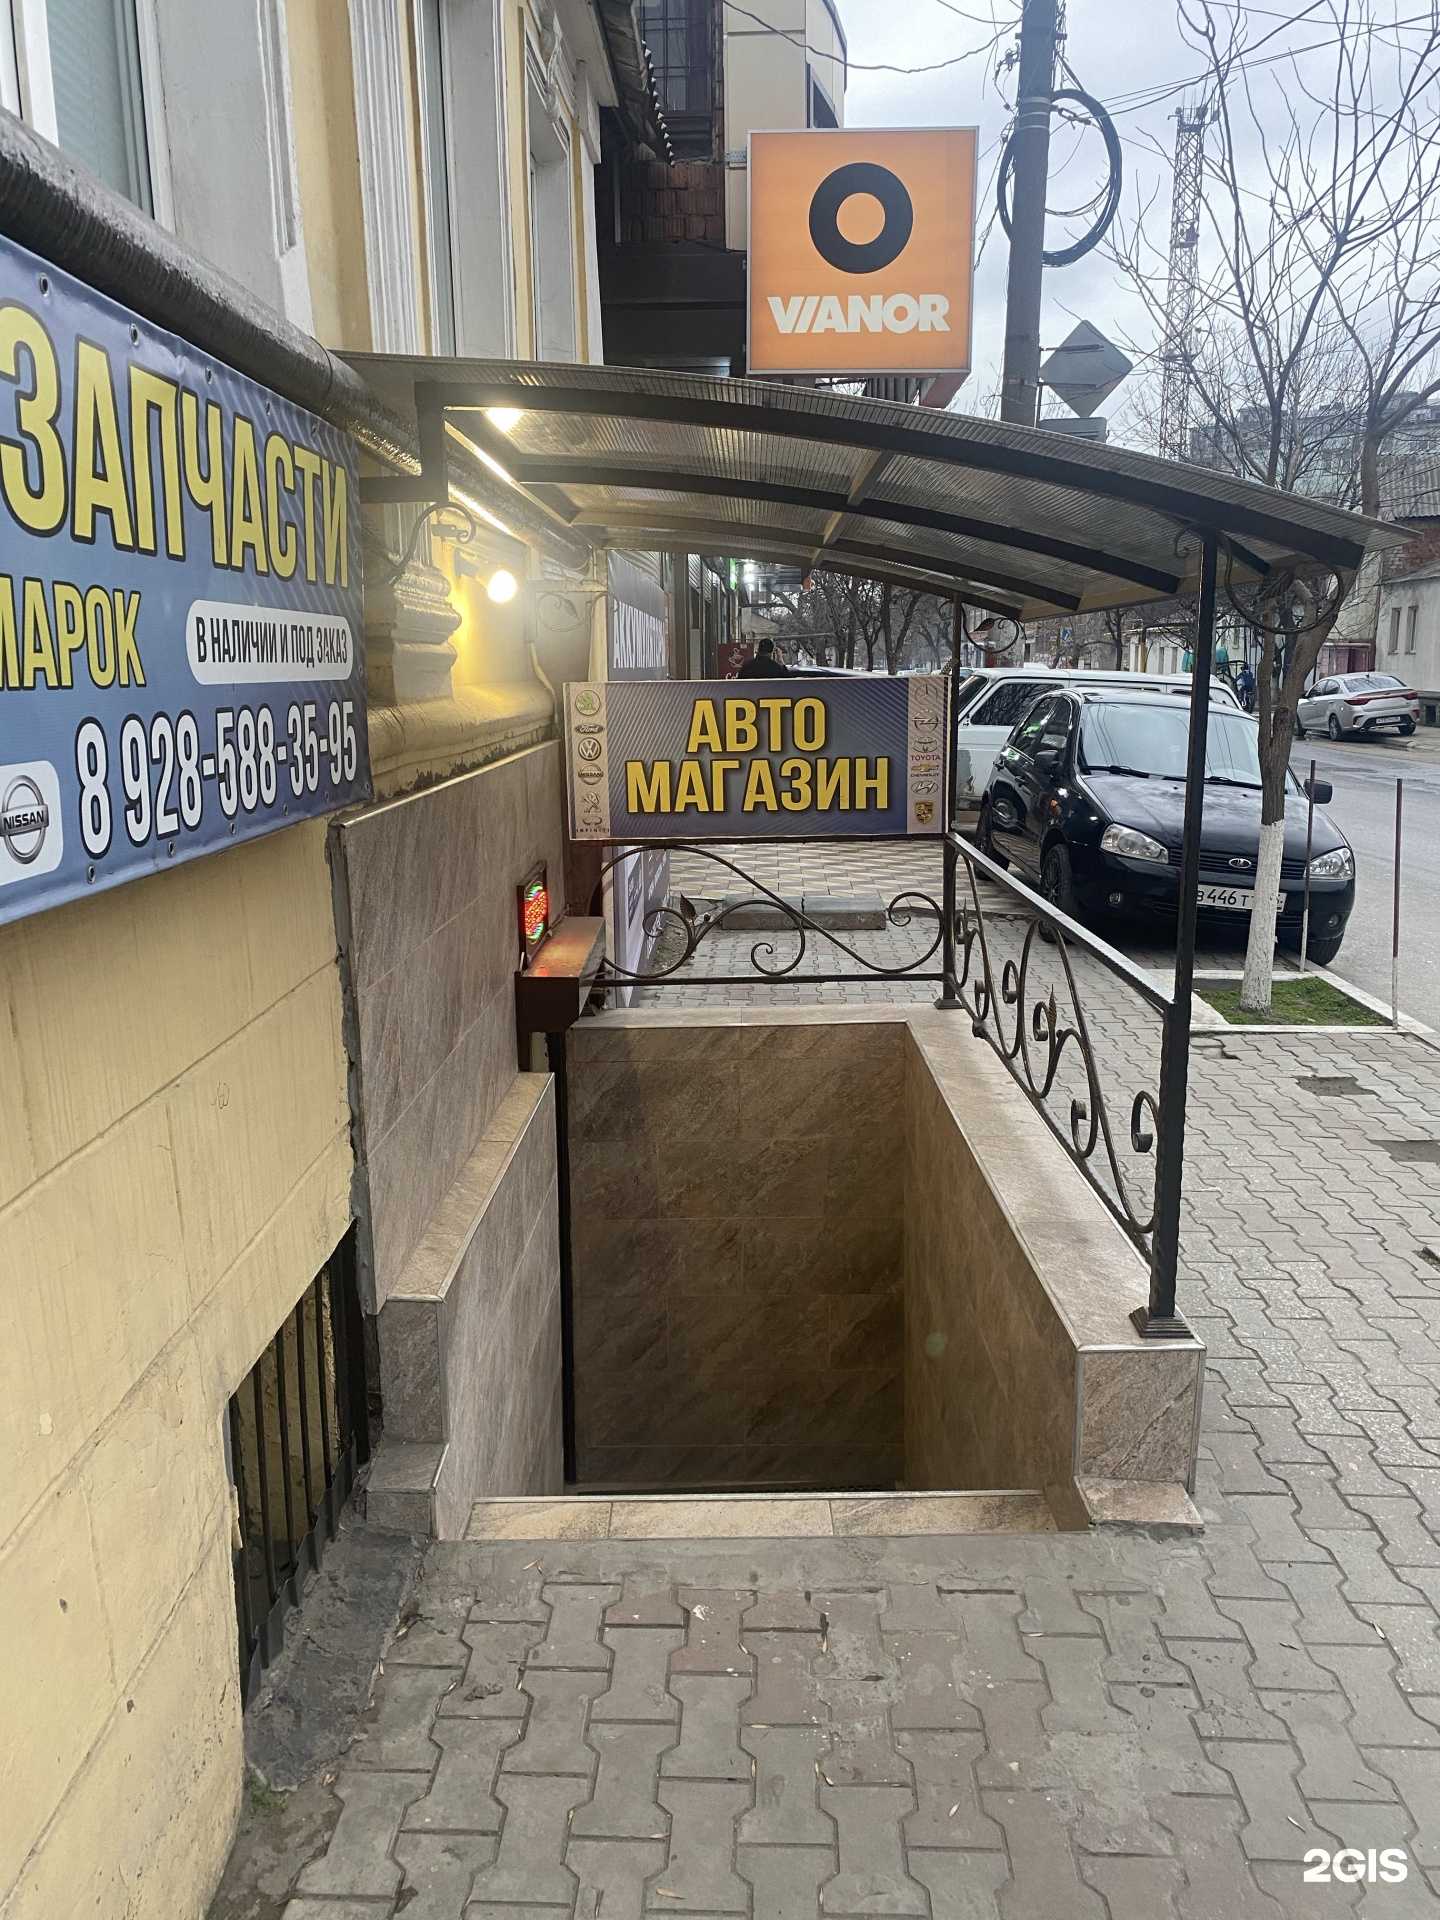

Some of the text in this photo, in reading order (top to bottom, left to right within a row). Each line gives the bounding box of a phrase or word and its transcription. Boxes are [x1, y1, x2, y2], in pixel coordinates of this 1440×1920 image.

[767, 293, 951, 334] VIANOR
[0, 301, 349, 589] ЗАПЧАСТИ
[196, 617, 348, 668] В НАЛИЧИИ И ПОД ЗАКАЗ
[687, 698, 826, 753] АВТО
[75, 701, 358, 858] 8 928-588-35-95
[625, 757, 889, 814] МАГАЗИН
[3, 810, 44, 830] NISSAN
